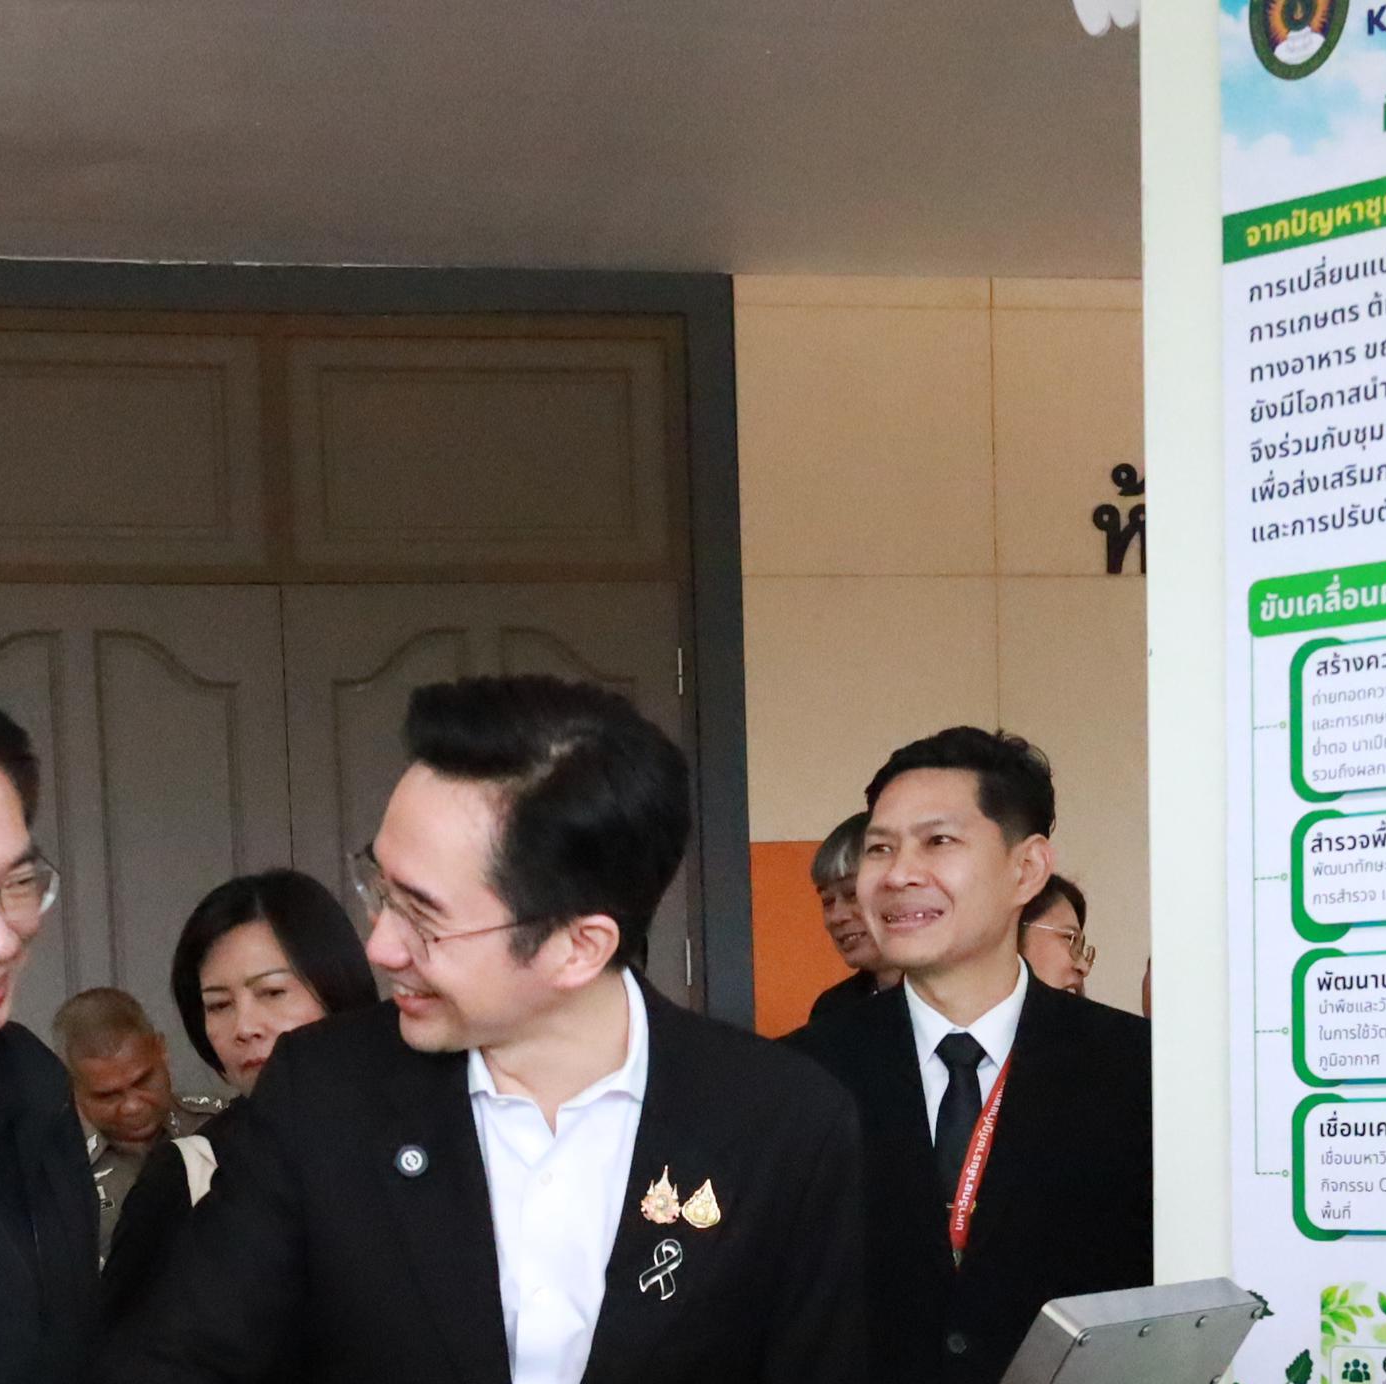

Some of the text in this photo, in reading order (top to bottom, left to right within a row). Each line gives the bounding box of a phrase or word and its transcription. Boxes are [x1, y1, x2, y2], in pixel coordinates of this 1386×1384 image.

[1248, 303, 1361, 344] การเกษตร
[1249, 347, 1356, 384] ทางอาหาร
[1318, 1052, 1380, 1072] ภูมิอากาศ
[1321, 1178, 1374, 1194] กิจกรรม
[1321, 1201, 1352, 1221] พื้นที่
